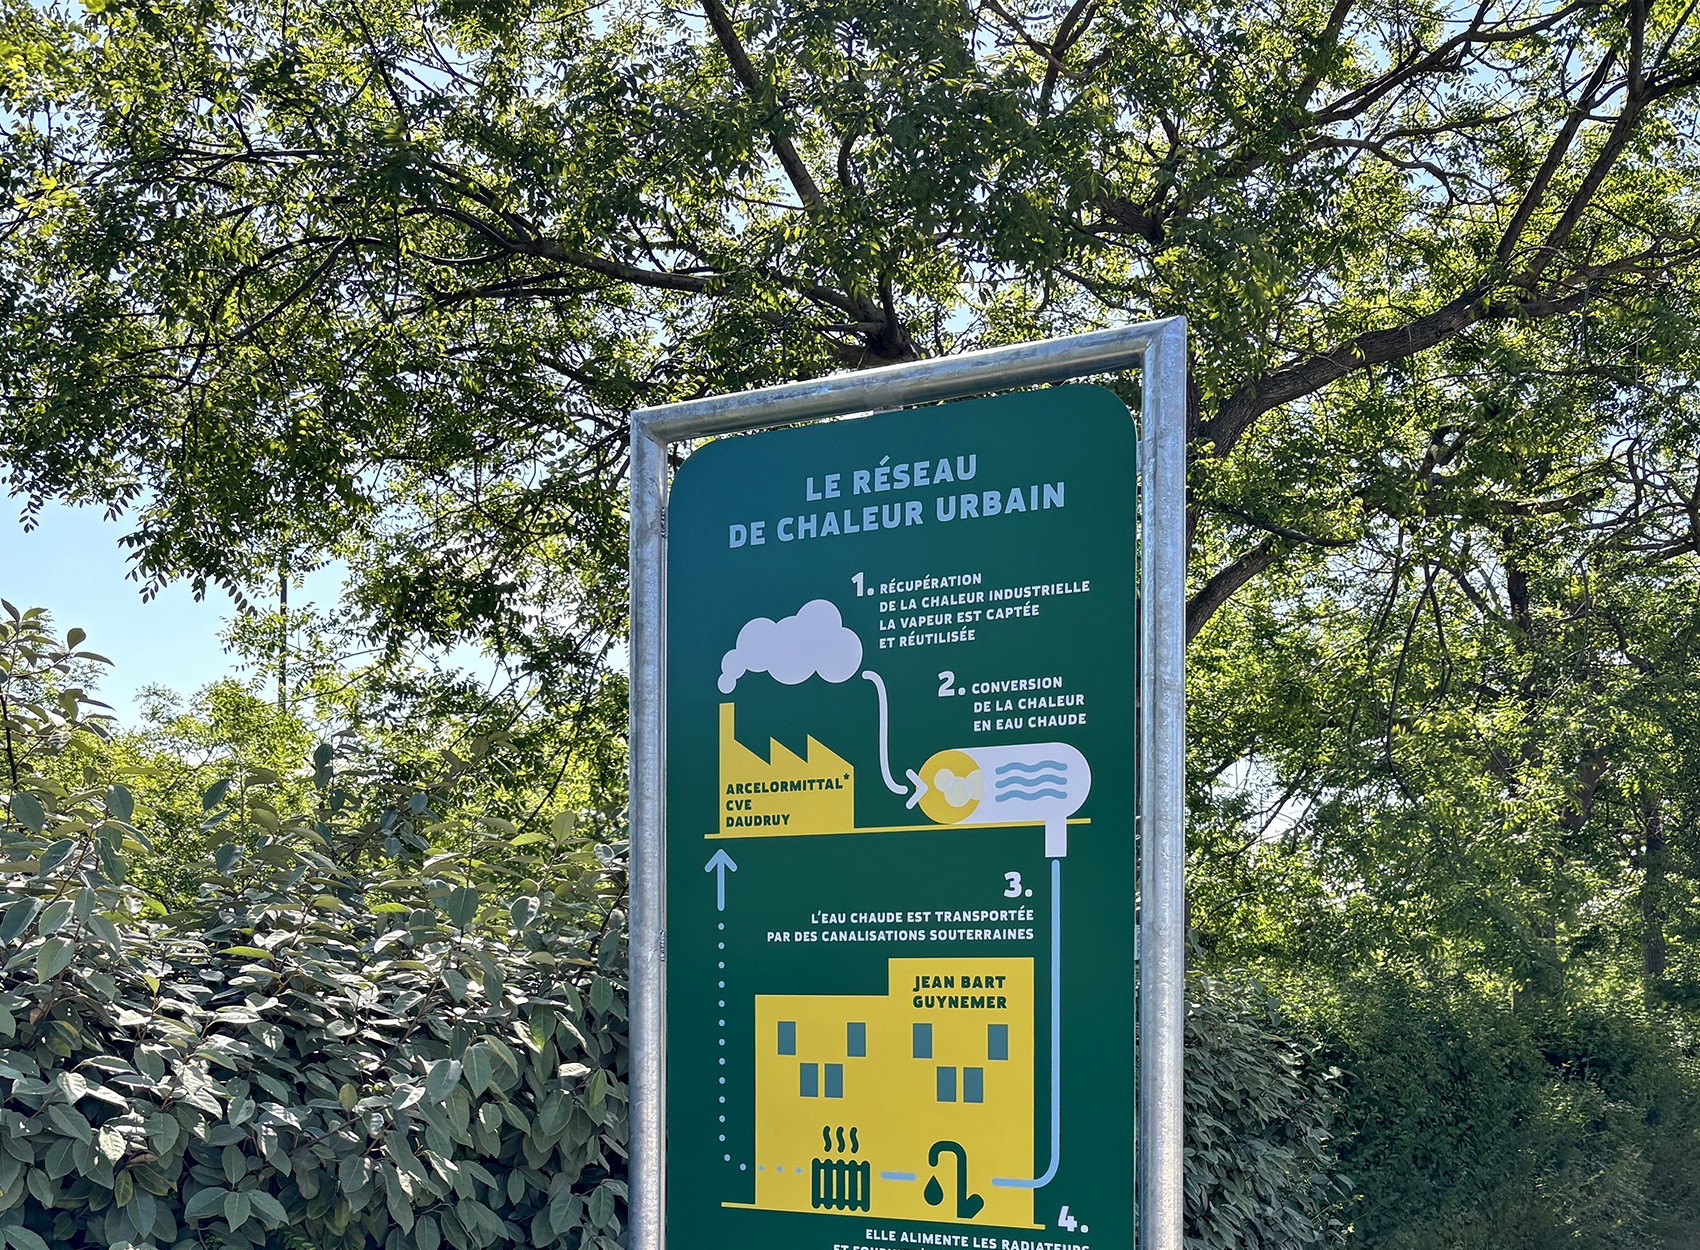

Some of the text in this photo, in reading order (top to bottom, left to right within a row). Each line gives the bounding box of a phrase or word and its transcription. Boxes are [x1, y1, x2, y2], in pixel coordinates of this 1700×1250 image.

[806, 453, 976, 501] LE RÉSEAU
[729, 481, 1064, 548] DE CHALEUR URBAIN
[851, 571, 981, 596] 1. RÉCUPÉRATION
[879, 580, 1089, 612] DE LA CHALEUR INDUSTRIELLE
[879, 600, 1039, 630] LA VAPEUR EST CAPTÉE
[879, 625, 975, 648] ET RÉUTILISÉE
[937, 670, 1062, 696] 2. CONVERSION
[973, 693, 1084, 712] DE LA CHALEUR
[973, 713, 1086, 731] EN EAU CHAUDE
[725, 799, 751, 811] CVE
[726, 814, 789, 827] DAUDRUY
[1003, 871, 1032, 897] 3.
[850, 911, 902, 923] CHAUDE
[907, 911, 931, 922] EST
[934, 905, 1033, 921] TRANSPORTÉE
[767, 928, 1033, 941] PAR DES CANALISATIONS SOUTERRAINES
[912, 975, 1005, 991] JEAN BART
[912, 995, 1006, 1008] GUYNEMER
[1057, 1205, 1088, 1233] 4.
[865, 1228, 896, 1241] ELLE
[900, 1231, 968, 1247] ALIMENTE
[973, 1236, 996, 1249] LES
